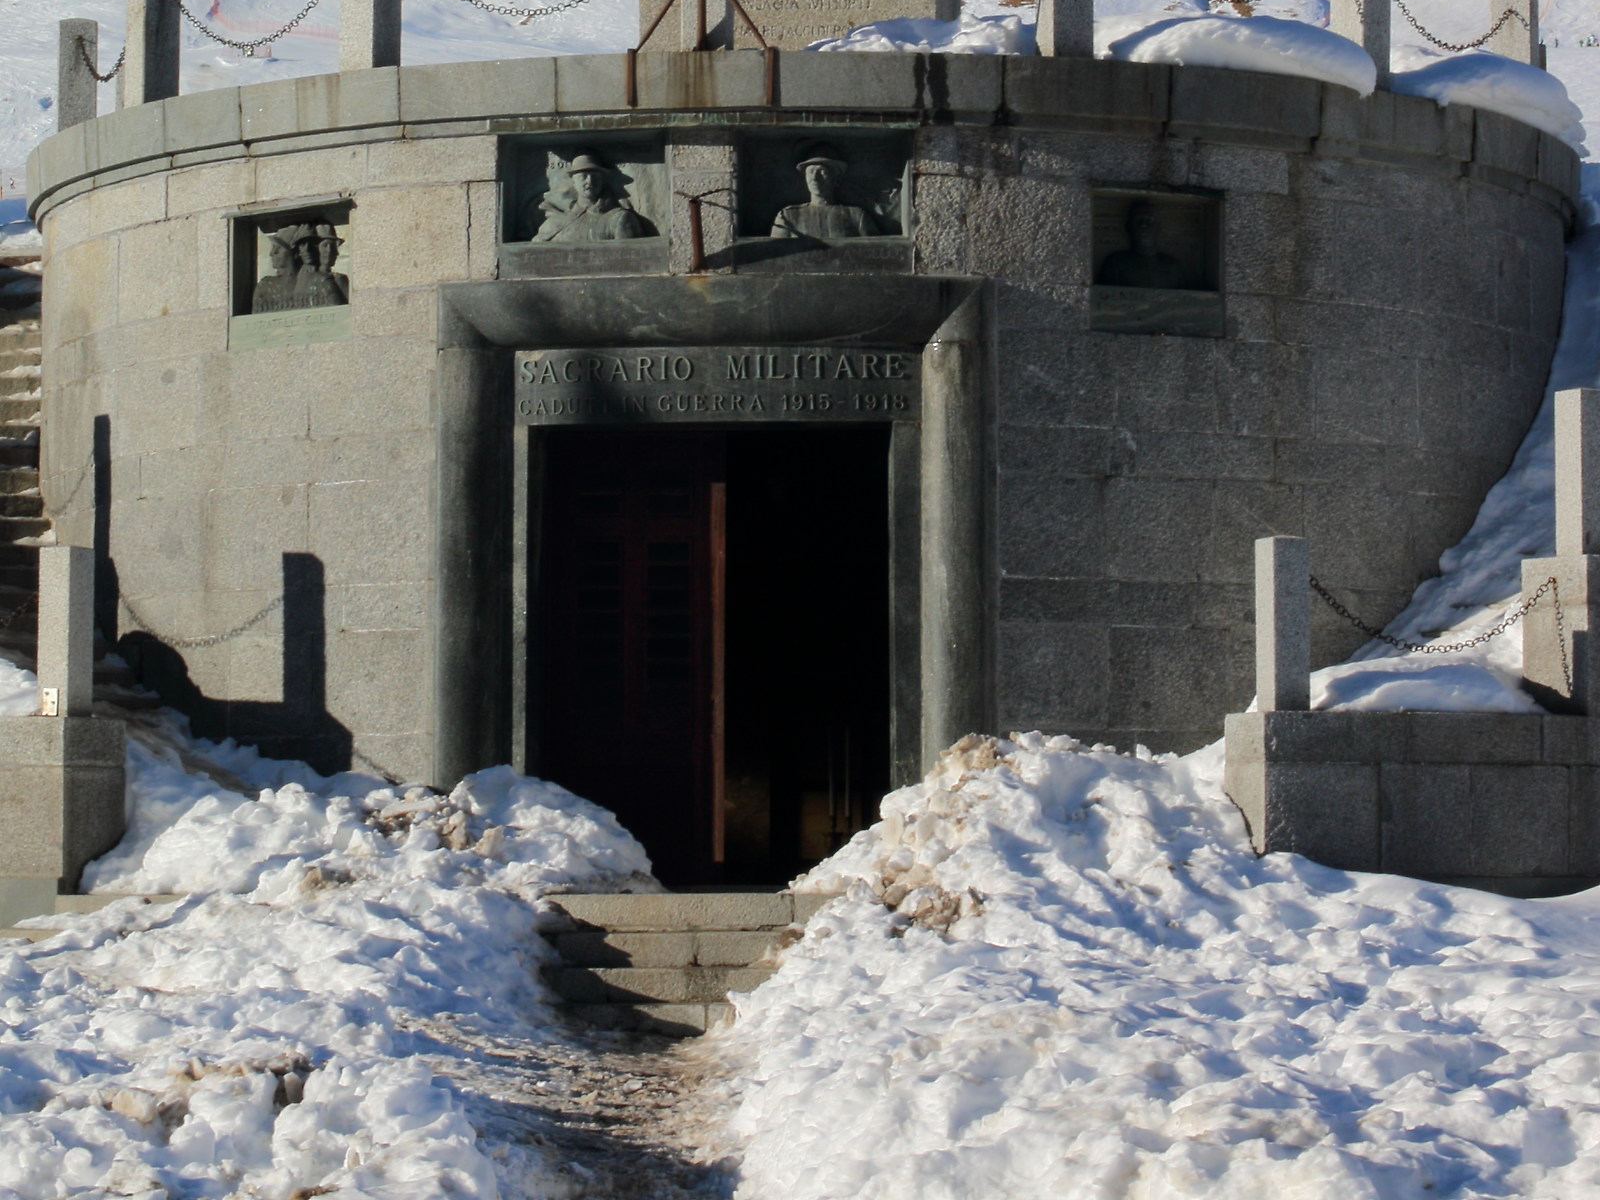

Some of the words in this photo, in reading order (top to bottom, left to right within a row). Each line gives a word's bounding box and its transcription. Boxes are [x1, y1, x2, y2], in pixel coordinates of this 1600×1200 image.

[520, 354, 695, 385] SACRARIO
[725, 352, 907, 380] MILITARE
[518, 396, 608, 417] CADUTI
[621, 394, 648, 413] IN
[656, 393, 765, 413] GUERRA
